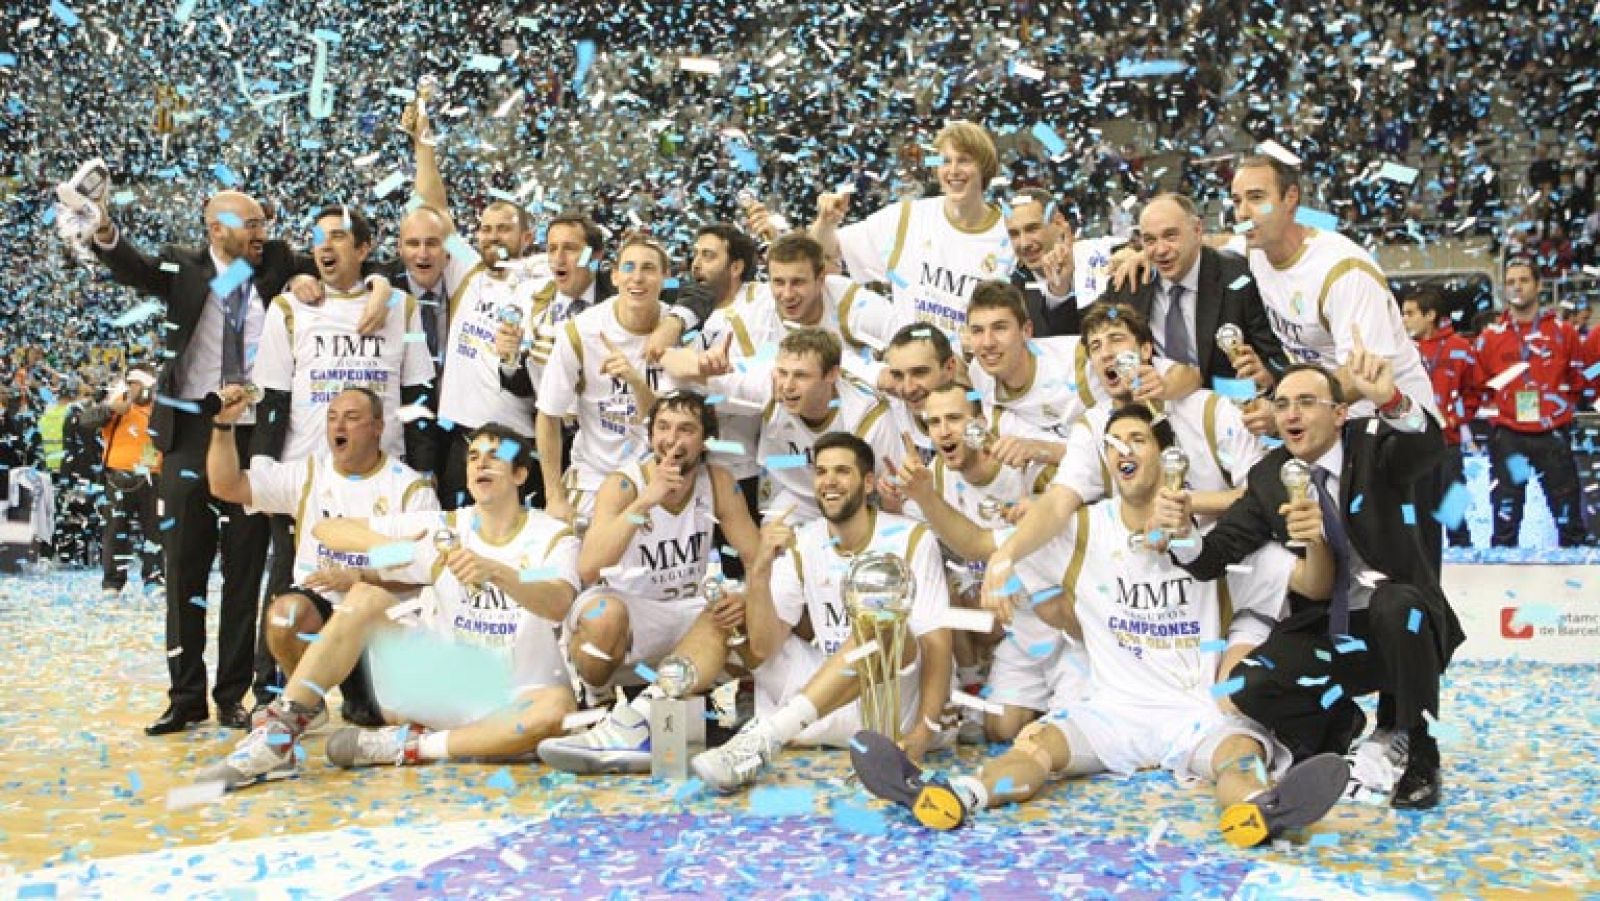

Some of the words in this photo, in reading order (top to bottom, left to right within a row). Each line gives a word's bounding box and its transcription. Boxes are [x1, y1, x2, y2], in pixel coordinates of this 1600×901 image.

[314, 335, 387, 358] MMT
[310, 369, 389, 382] CAMPEONES
[637, 531, 709, 571] MMT
[1115, 577, 1194, 610] MMT
[1108, 615, 1201, 638] CAMPEONES
